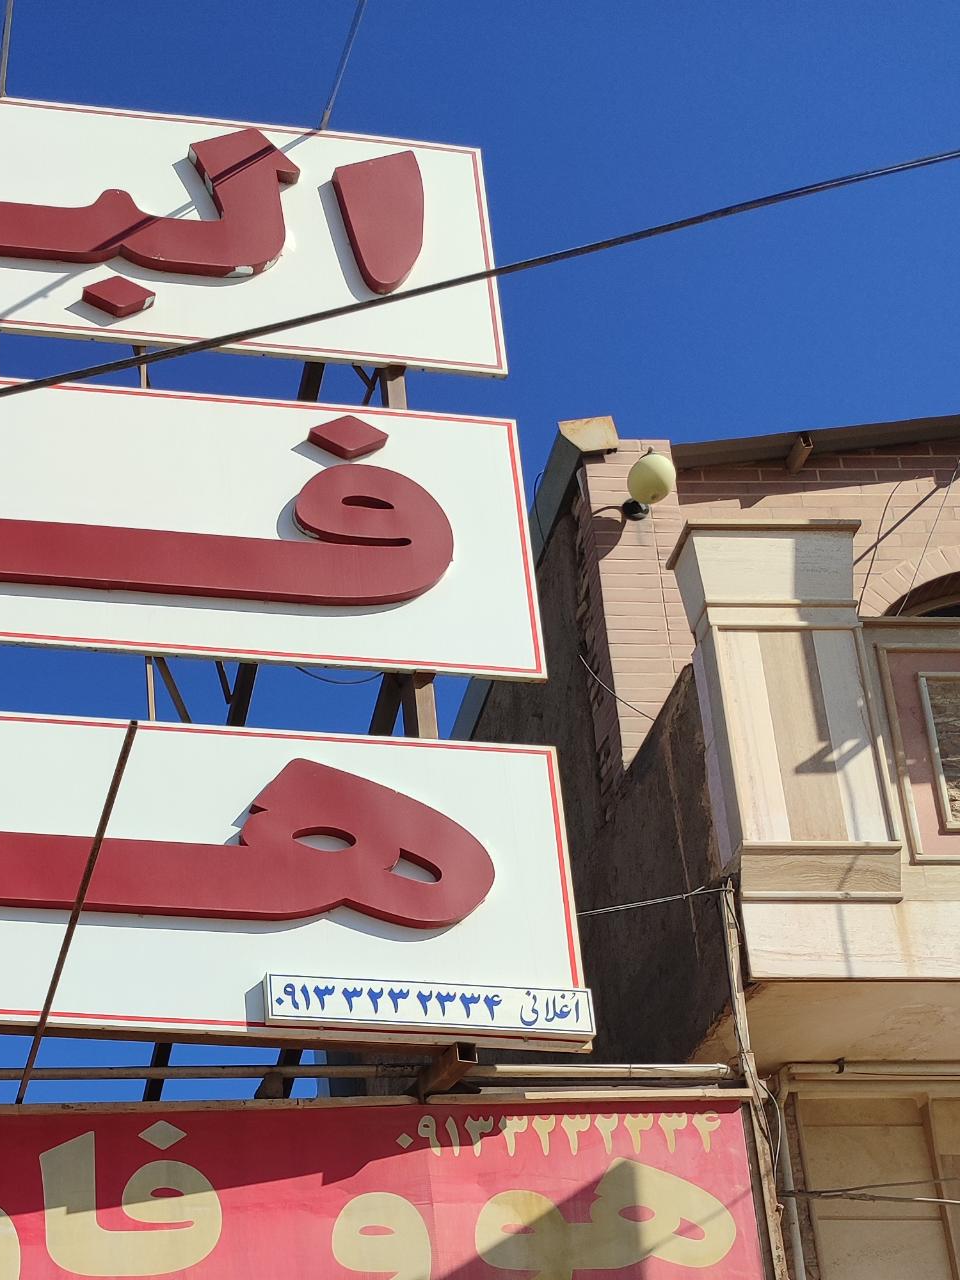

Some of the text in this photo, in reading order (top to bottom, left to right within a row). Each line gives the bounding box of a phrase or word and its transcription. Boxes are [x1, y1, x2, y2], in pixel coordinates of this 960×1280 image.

[275, 983, 336, 1011] ۰۹۱۳
[341, 987, 410, 1014] ۳۲۳
[416, 990, 503, 1021] ۲۳۳۴
[395, 1109, 722, 1157] ۰۹۱۳۳۲۳۲۳۳۴
